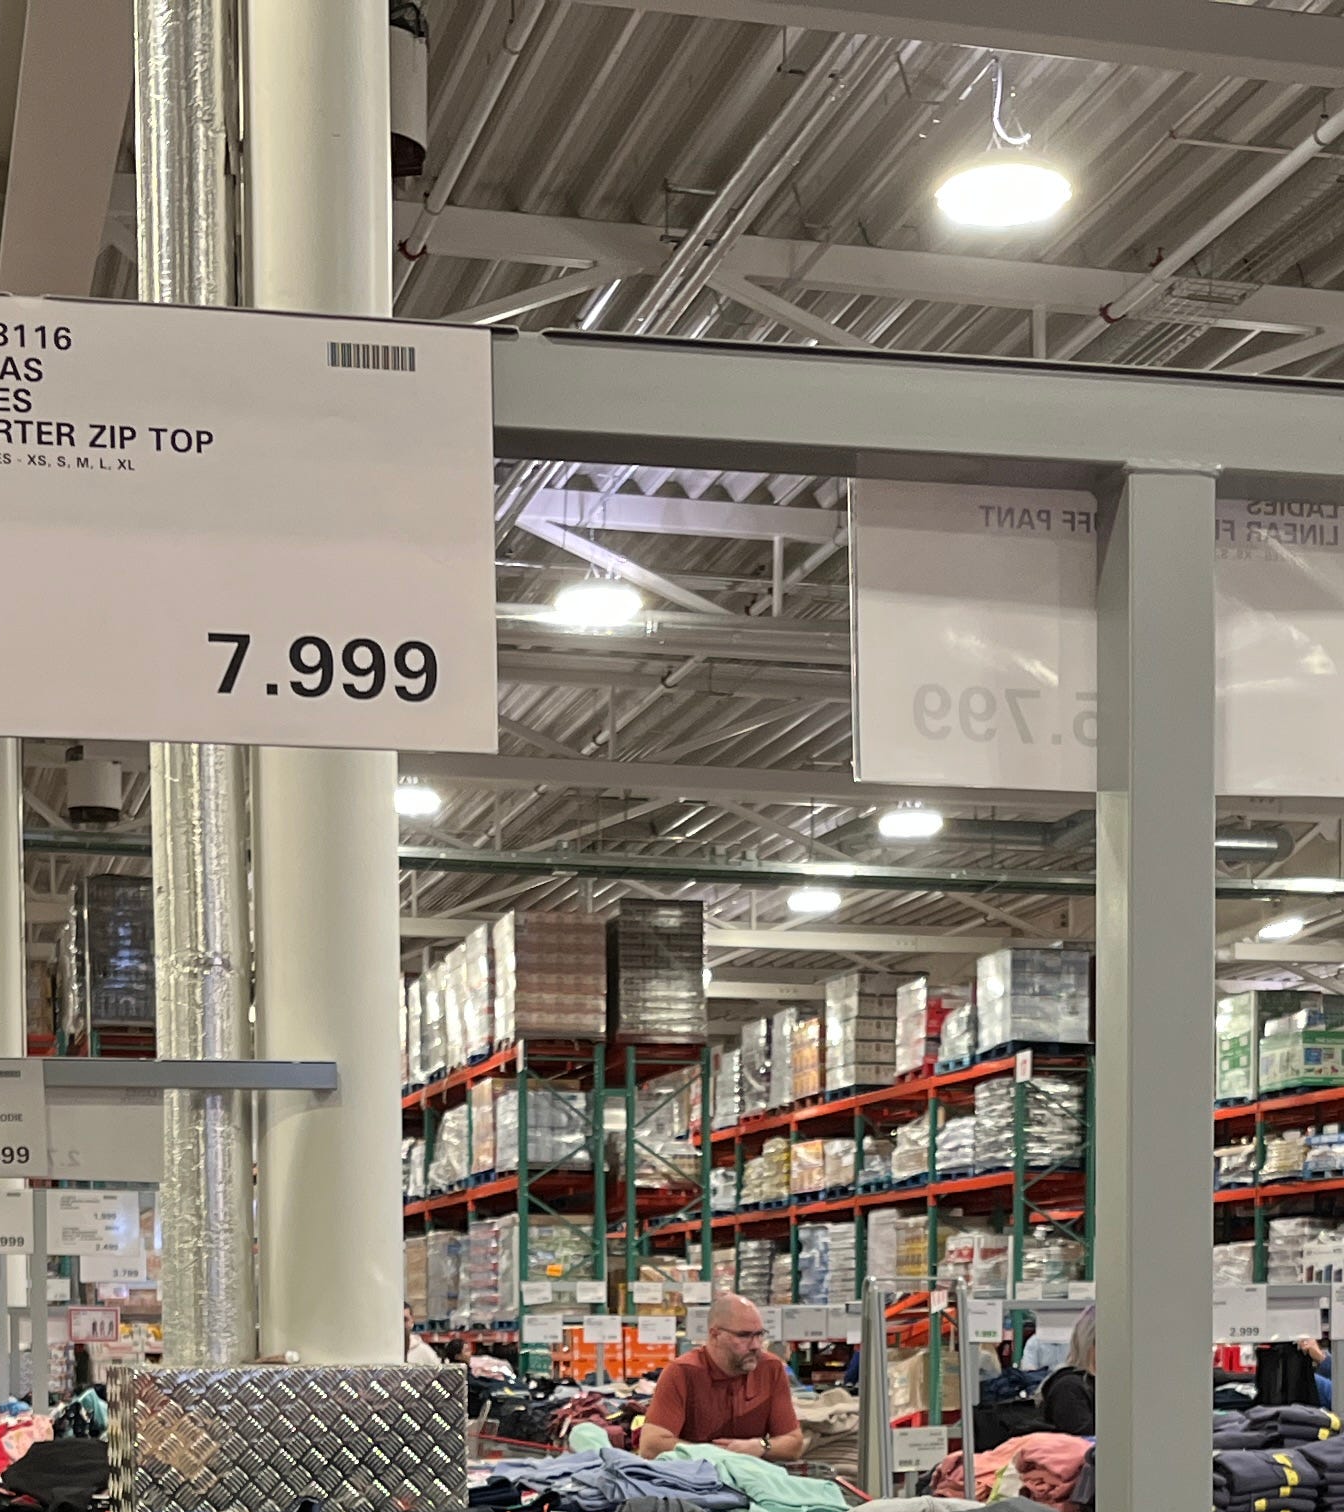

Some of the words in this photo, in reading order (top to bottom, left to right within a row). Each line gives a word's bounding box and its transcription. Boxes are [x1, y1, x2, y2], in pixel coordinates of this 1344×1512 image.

[88, 424, 138, 451] ZIP
[148, 427, 215, 454] TOP
[116, 456, 136, 472] XL
[206, 631, 438, 702] 7.999
[1229, 1326, 1260, 1338] 2.999
